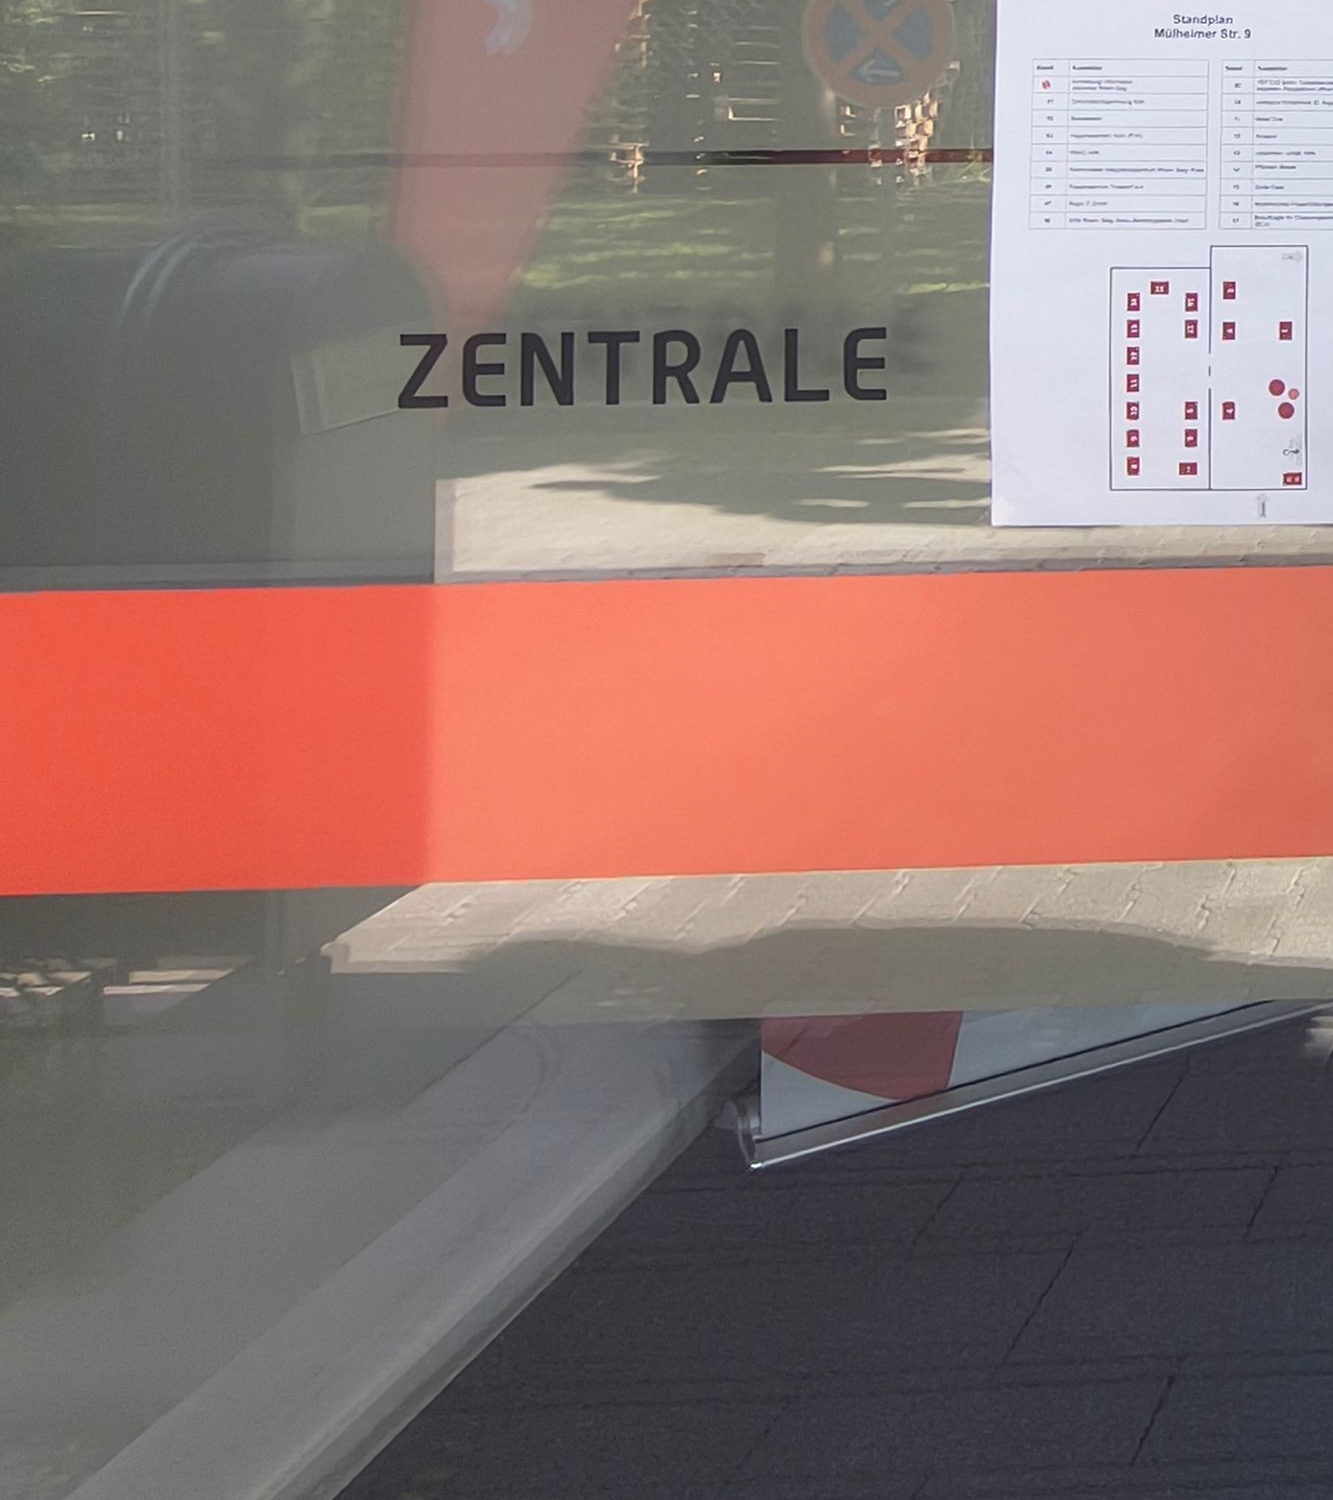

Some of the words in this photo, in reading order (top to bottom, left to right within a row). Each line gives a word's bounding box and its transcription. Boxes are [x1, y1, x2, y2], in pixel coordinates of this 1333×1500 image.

[1173, 14, 1234, 27] Standplan
[1154, 28, 1217, 39] Mülheimer
[1220, 28, 1241, 39] Str.
[1244, 28, 1252, 39] 9
[398, 325, 889, 412] ZENTRALE
